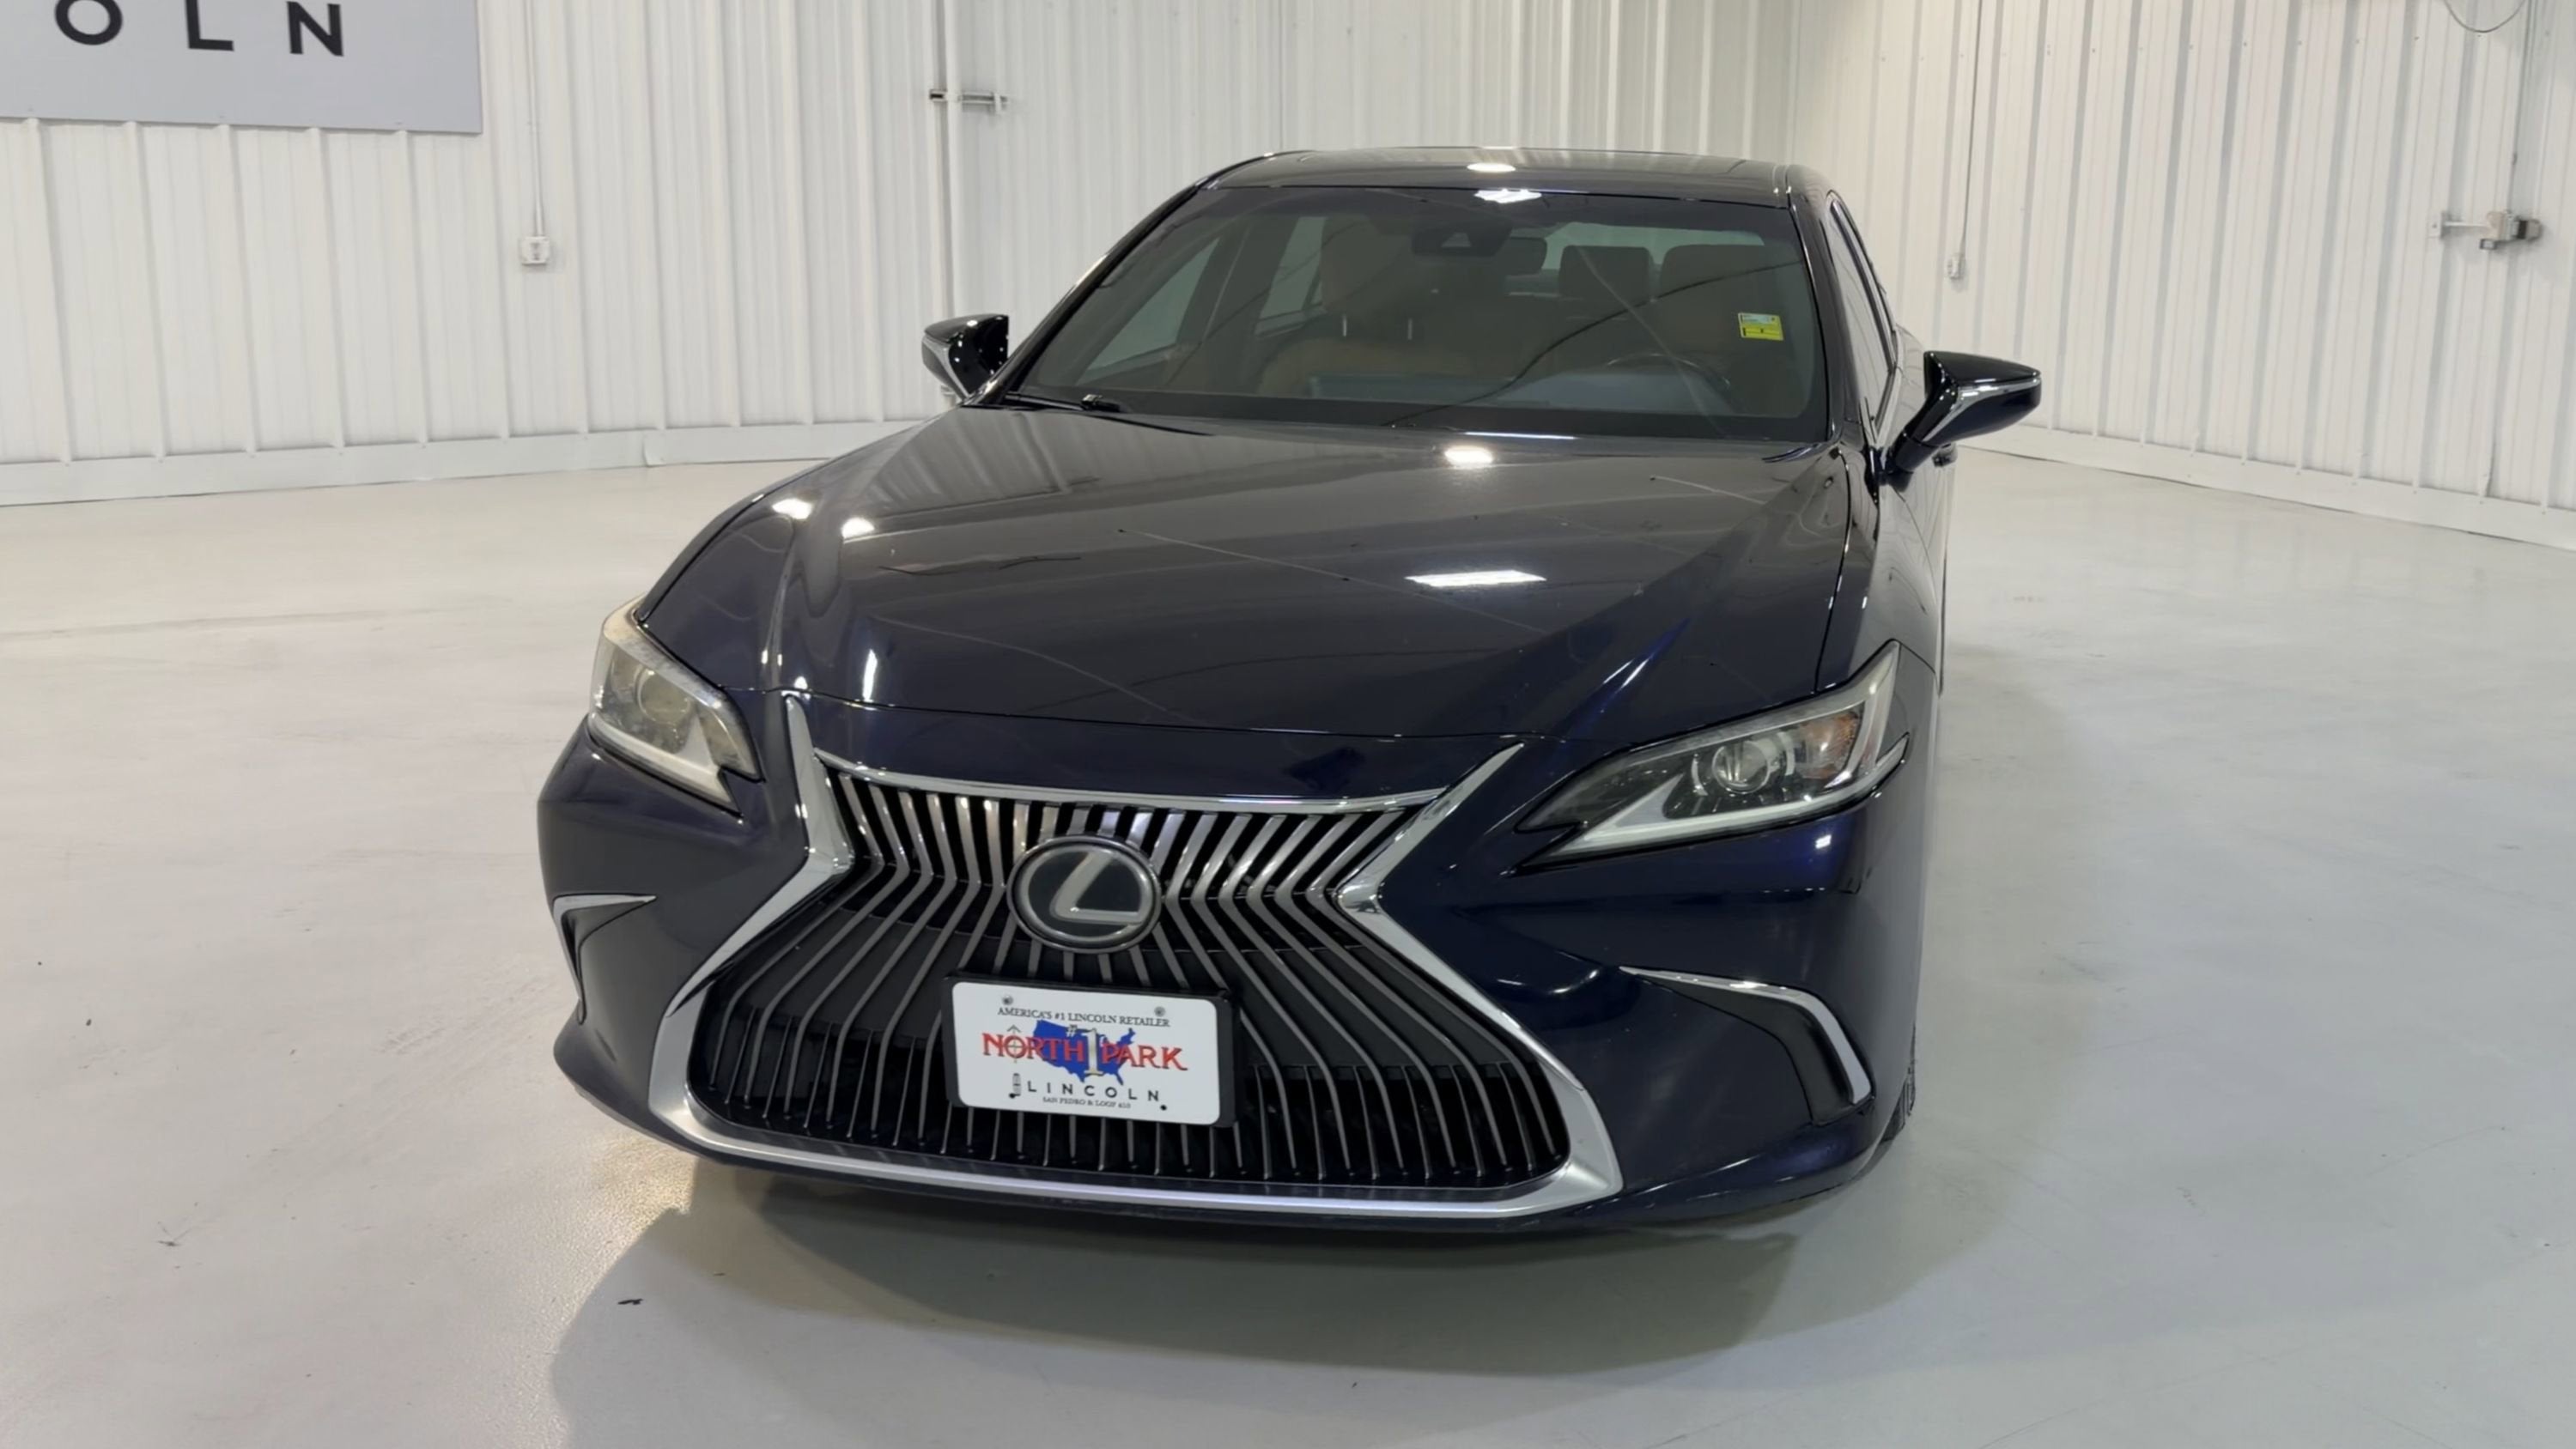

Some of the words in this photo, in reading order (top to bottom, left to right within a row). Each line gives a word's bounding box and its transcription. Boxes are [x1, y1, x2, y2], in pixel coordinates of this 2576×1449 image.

[997, 1007, 1053, 1019] AMERICA'S
[1054, 1012, 1066, 1021] #1
[1067, 1012, 1118, 1024] LINCOLN
[1119, 1016, 1170, 1028] RETAILER
[981, 1032, 1084, 1063] NORTH
[1102, 1042, 1188, 1071] PARK
[1027, 1081, 1159, 1102] LINCOLN
